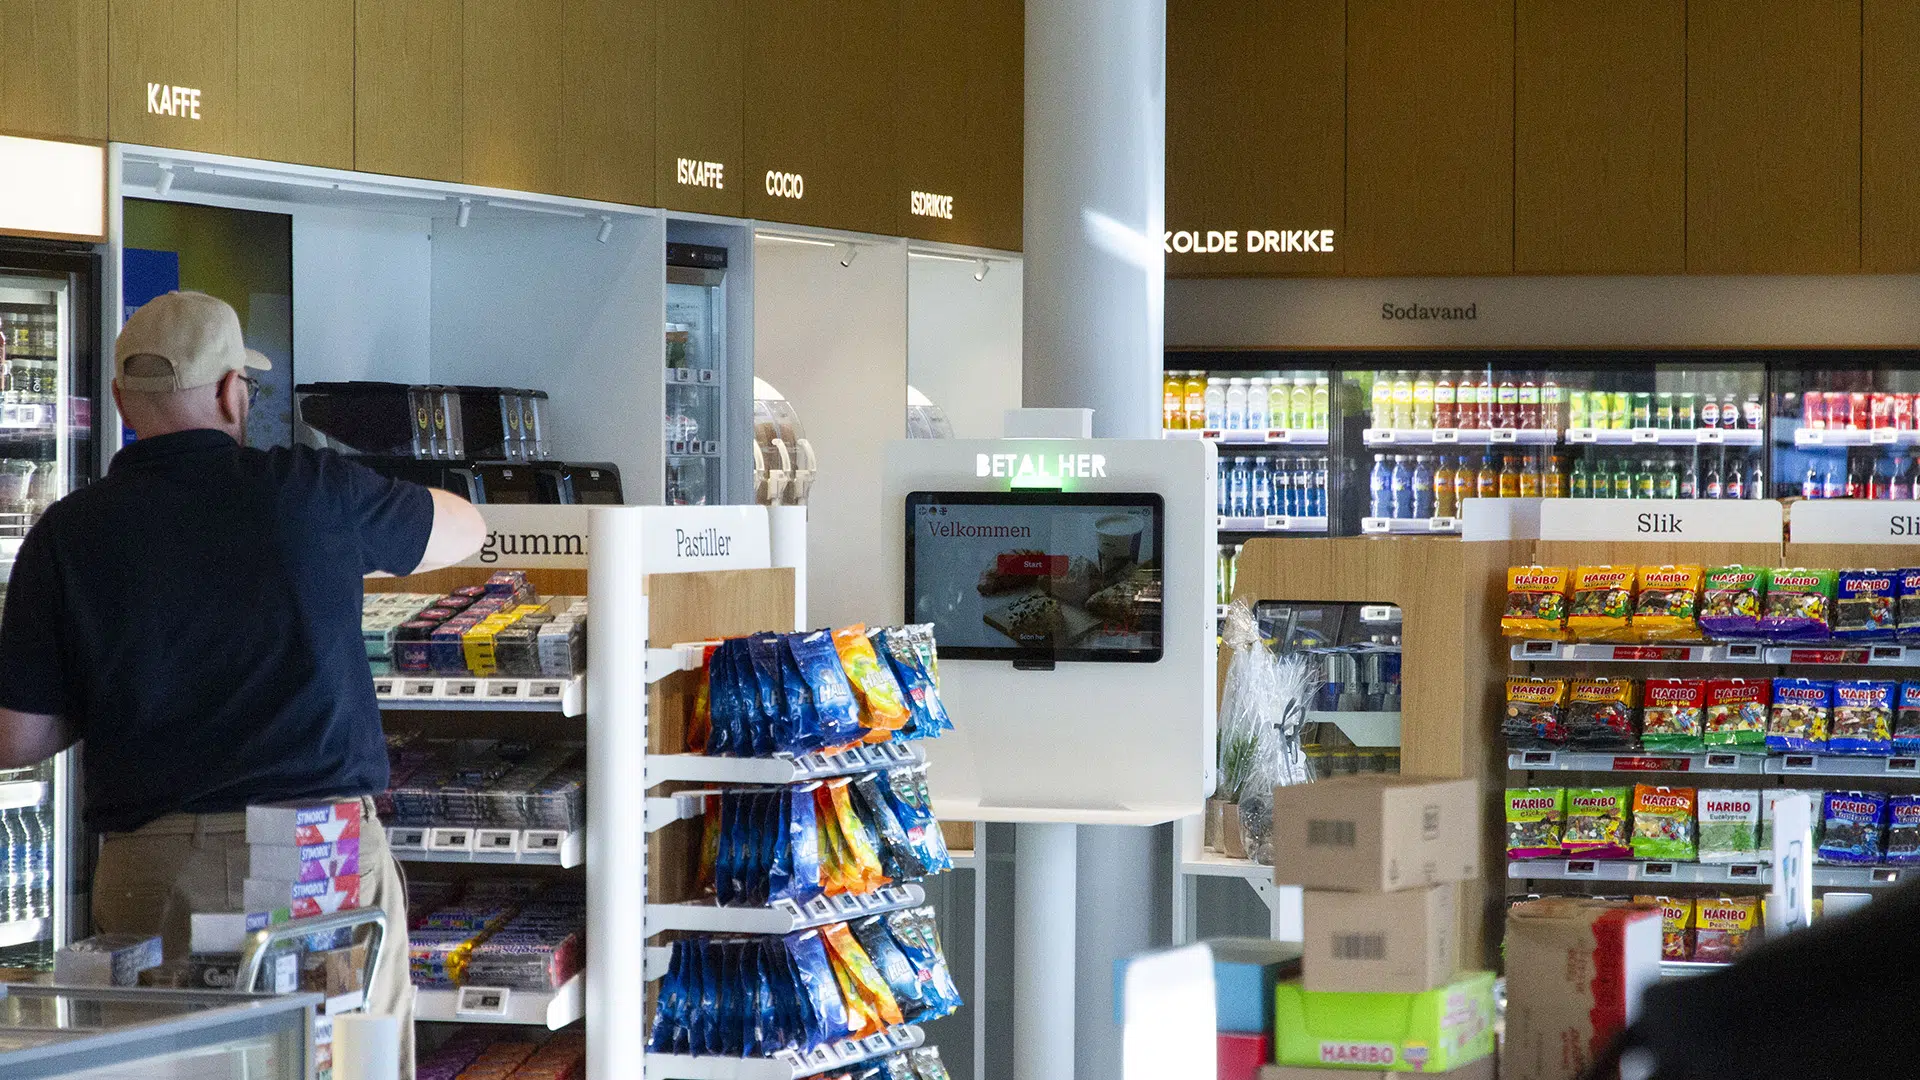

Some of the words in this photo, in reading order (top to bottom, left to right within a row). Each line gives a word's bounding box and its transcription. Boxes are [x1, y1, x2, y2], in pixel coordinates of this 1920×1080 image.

[147, 83, 201, 119] KAFFE
[677, 158, 724, 190] ISKAFFE
[765, 170, 803, 200] COCIO
[910, 190, 953, 220] ISDRIKKE
[1164, 230, 1238, 253] KOLDE
[1246, 229, 1335, 253] DRIKKE
[1381, 302, 1477, 320] Sodavand
[976, 453, 1050, 478] BETAL
[1058, 453, 1107, 478] HER
[1637, 513, 1683, 533] Slik
[928, 521, 1032, 539] Velkommen
[480, 531, 588, 563] gumm
[676, 528, 731, 557] Pastiller
[1514, 575, 1558, 585] HARIBO
[1583, 572, 1626, 584] HARIBO
[1645, 574, 1690, 583] HARIBO
[1774, 576, 1820, 587] HARIBO
[1846, 579, 1890, 592] HARIBO
[1512, 685, 1556, 695] HARIBO
[1577, 685, 1620, 695] HARIBO
[1652, 688, 1697, 700] HARIBO
[1714, 686, 1759, 699] HARIBO
[1779, 687, 1825, 699] HARIBO
[1840, 688, 1887, 700] HARIBO
[1512, 797, 1555, 809] HARIBO
[1573, 796, 1616, 807] HARIBO
[1707, 801, 1751, 813] HARIBO
[1832, 800, 1877, 814] HARIBO
[1703, 908, 1747, 920] HARIBO
[1321, 1044, 1395, 1064] HARIBO
